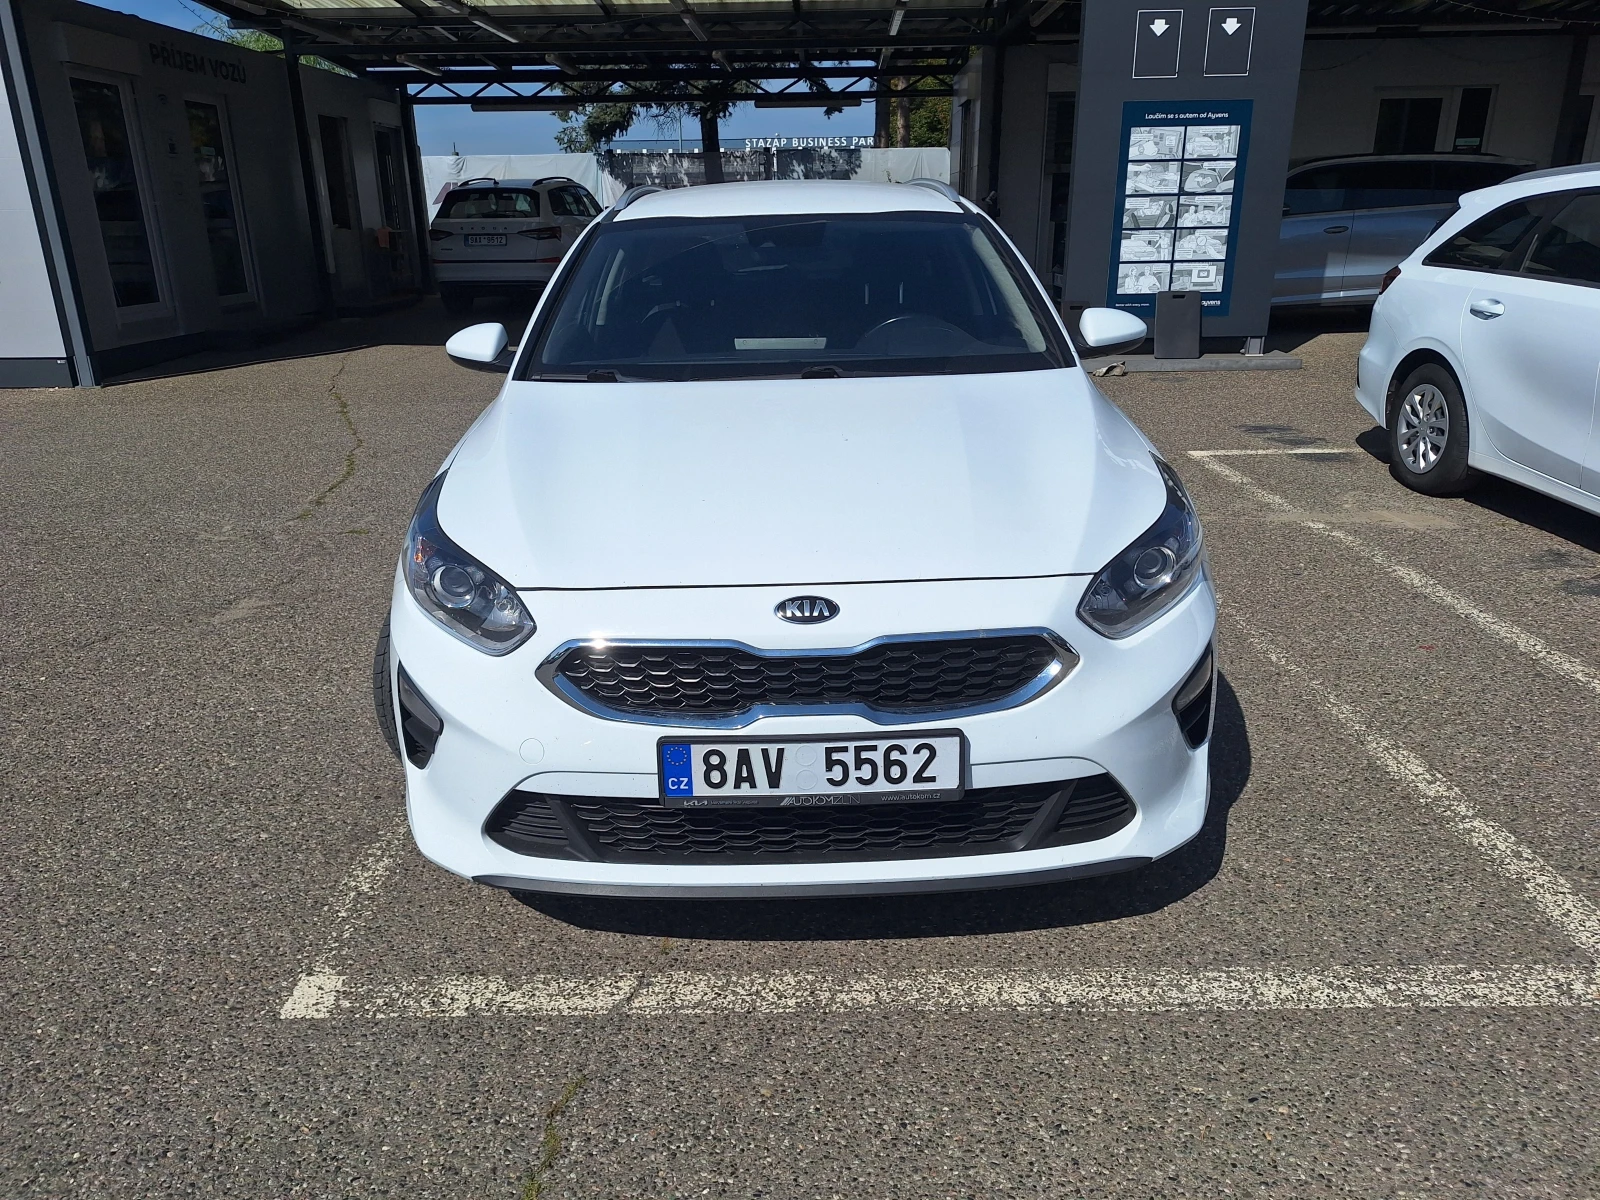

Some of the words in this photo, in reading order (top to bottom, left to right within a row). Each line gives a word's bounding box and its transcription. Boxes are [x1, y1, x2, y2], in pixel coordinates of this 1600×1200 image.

[149, 41, 206, 75] PŘÍJEM
[208, 56, 246, 84] VOZŮ
[1145, 112, 1167, 120] Loučím
[1208, 112, 1229, 120] Ayvens
[792, 137, 847, 147] BUSINESS
[785, 599, 830, 617] KIA
[702, 747, 785, 789] 8AV
[824, 742, 937, 787] 5562
[668, 777, 689, 790] CZ
[881, 792, 941, 801] www.autokom.cz
